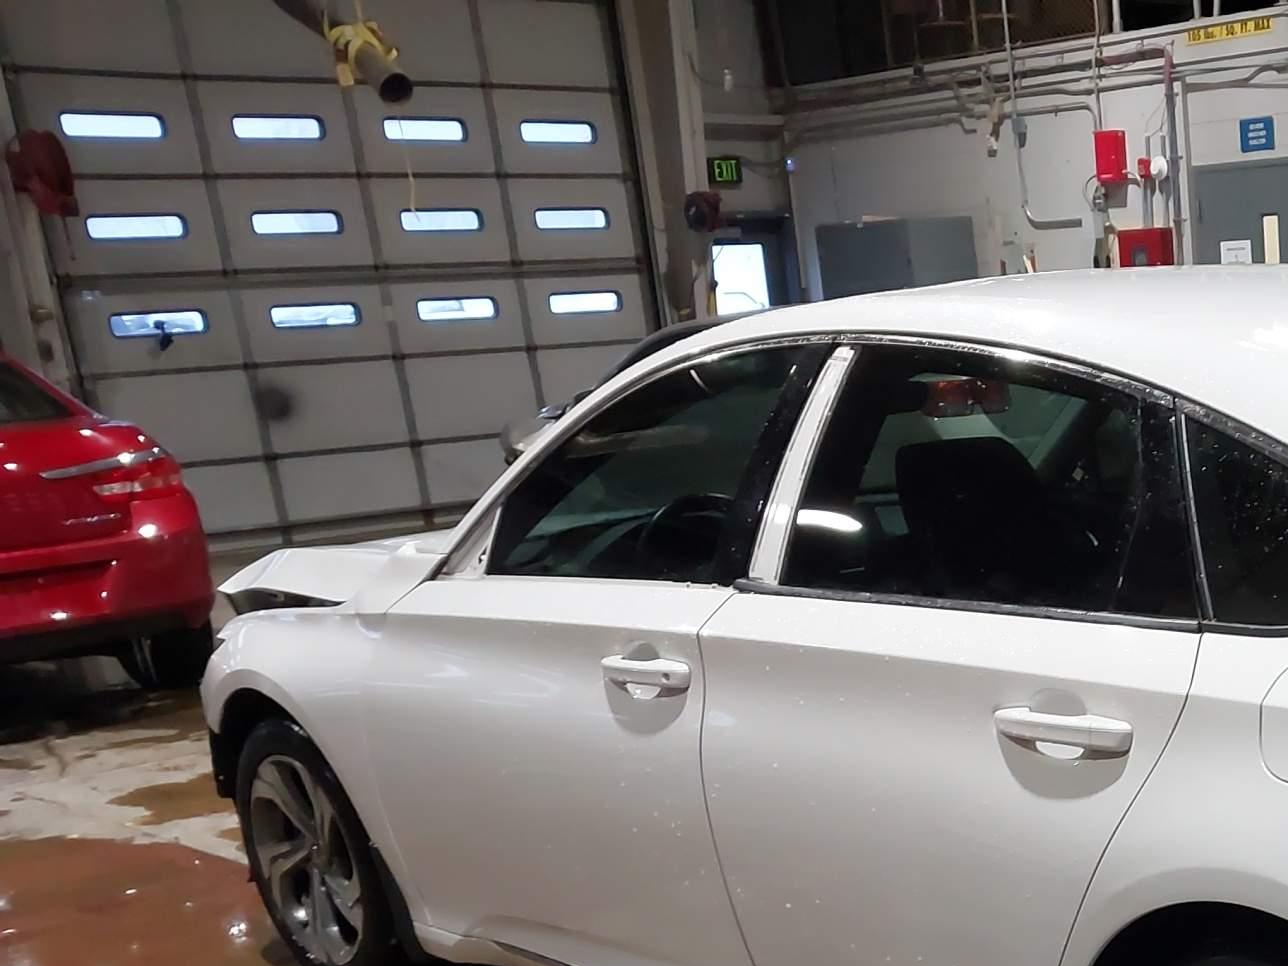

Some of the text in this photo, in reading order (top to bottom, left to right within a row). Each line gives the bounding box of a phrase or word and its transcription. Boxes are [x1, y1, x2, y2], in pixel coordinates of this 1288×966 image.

[1187, 28, 1201, 42] 105
[1254, 17, 1271, 31] MAX
[714, 160, 736, 181] EXIT
